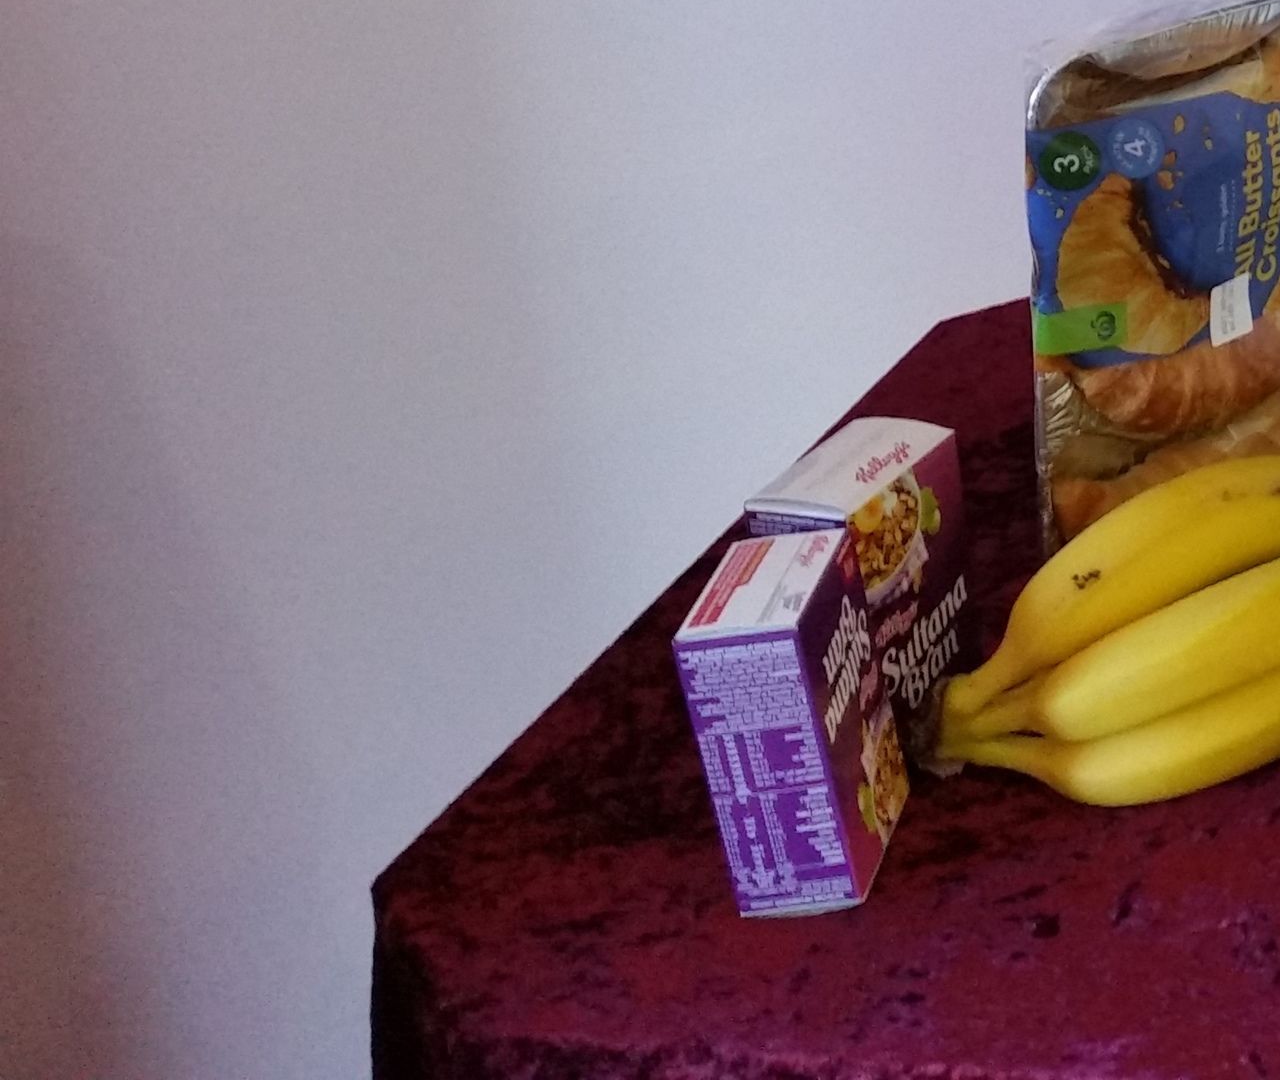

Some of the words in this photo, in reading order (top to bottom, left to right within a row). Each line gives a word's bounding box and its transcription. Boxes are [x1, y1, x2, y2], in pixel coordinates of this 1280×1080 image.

[1053, 153, 1081, 174] 3
[1123, 138, 1146, 157] 4
[1237, 131, 1264, 237] Butter
[1234, 243, 1256, 279] All
[822, 594, 857, 686] Bran
[823, 606, 872, 745] Sultana
[881, 574, 969, 697] Sultana
[901, 628, 960, 711] Bran
